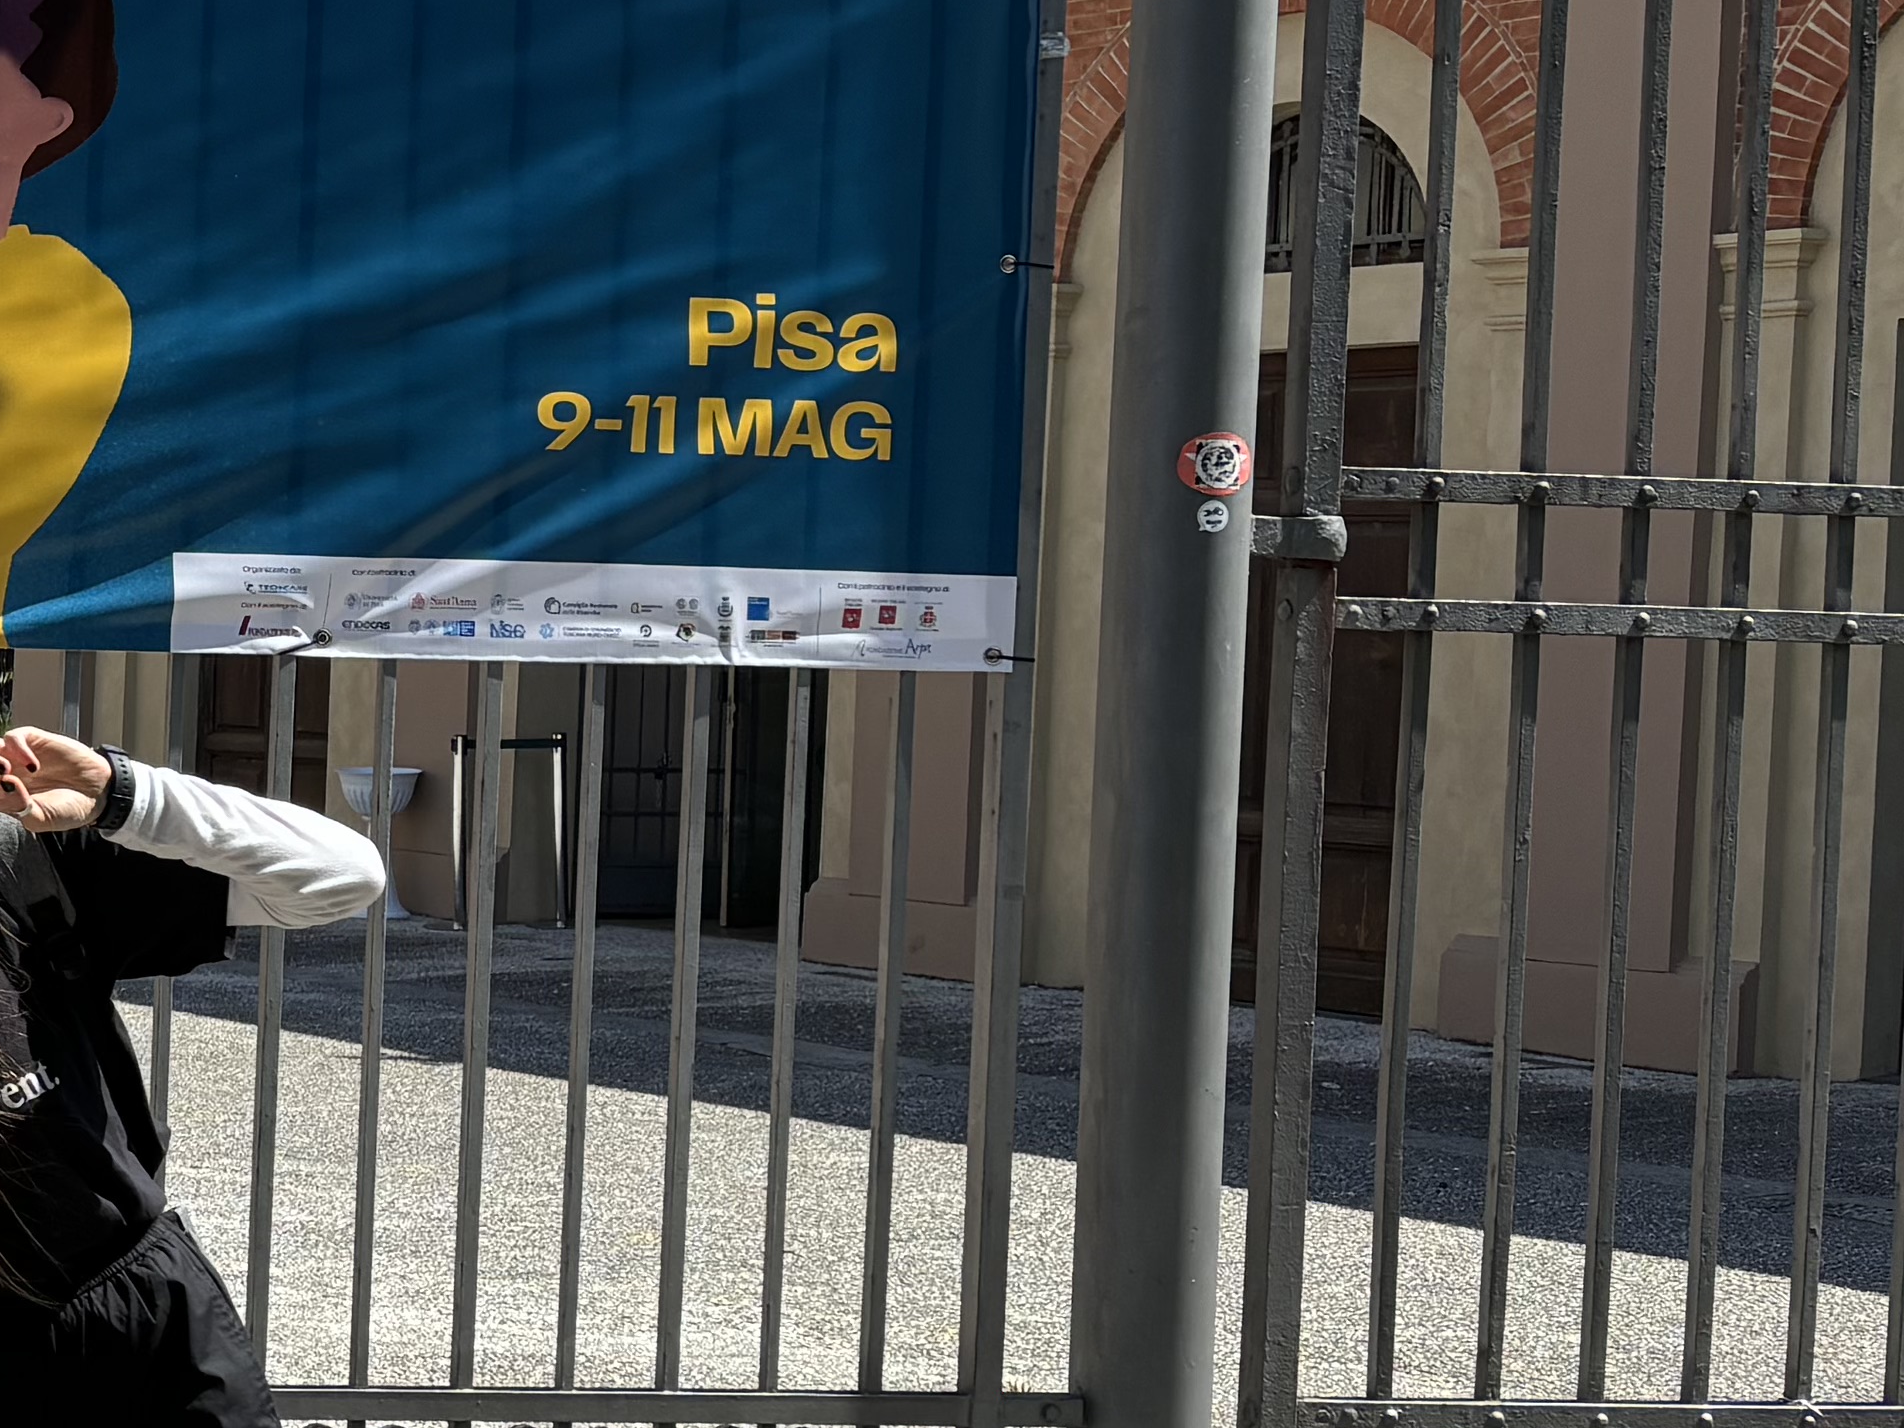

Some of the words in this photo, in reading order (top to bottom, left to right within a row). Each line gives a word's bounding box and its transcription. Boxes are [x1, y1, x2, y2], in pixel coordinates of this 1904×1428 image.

[689, 294, 898, 373] Pisa
[538, 392, 677, 455] 9-11
[698, 398, 892, 461] MAG
